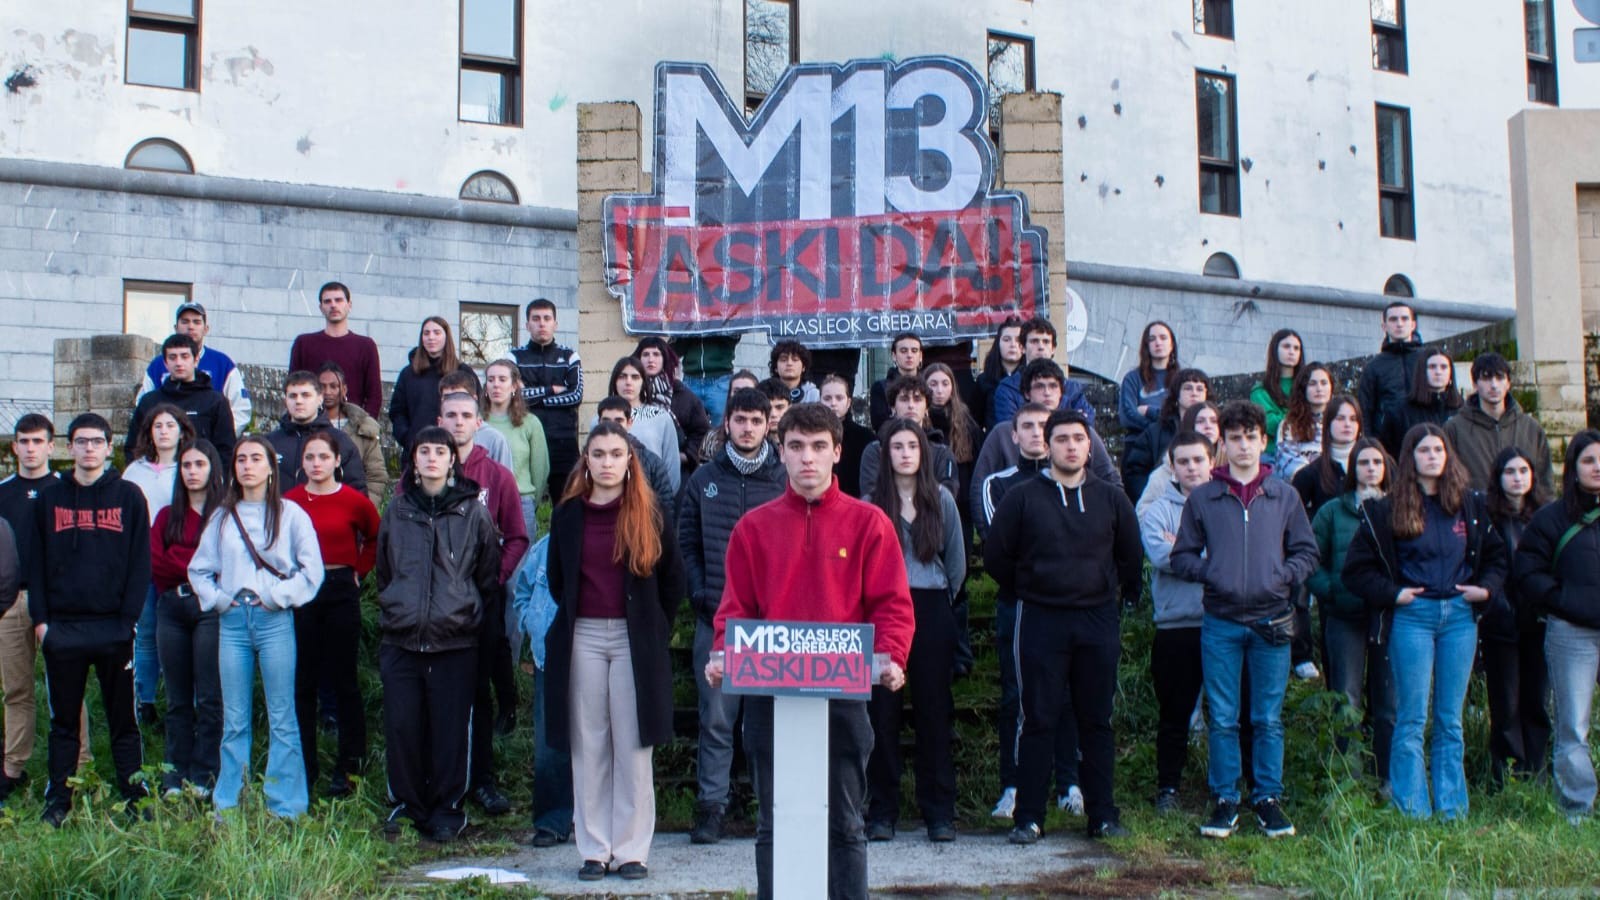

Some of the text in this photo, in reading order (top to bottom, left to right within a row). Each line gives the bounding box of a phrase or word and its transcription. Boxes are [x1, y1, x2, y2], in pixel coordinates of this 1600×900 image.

[664, 67, 983, 226] M13
[644, 217, 1002, 308] ASKI DA!
[779, 313, 952, 336] IKASLEOK GREBARA!
[734, 625, 790, 654] M13
[791, 628, 861, 642] IKASLEOK
[791, 641, 863, 654] GREBARA!
[735, 656, 860, 683] ASKI DA!
